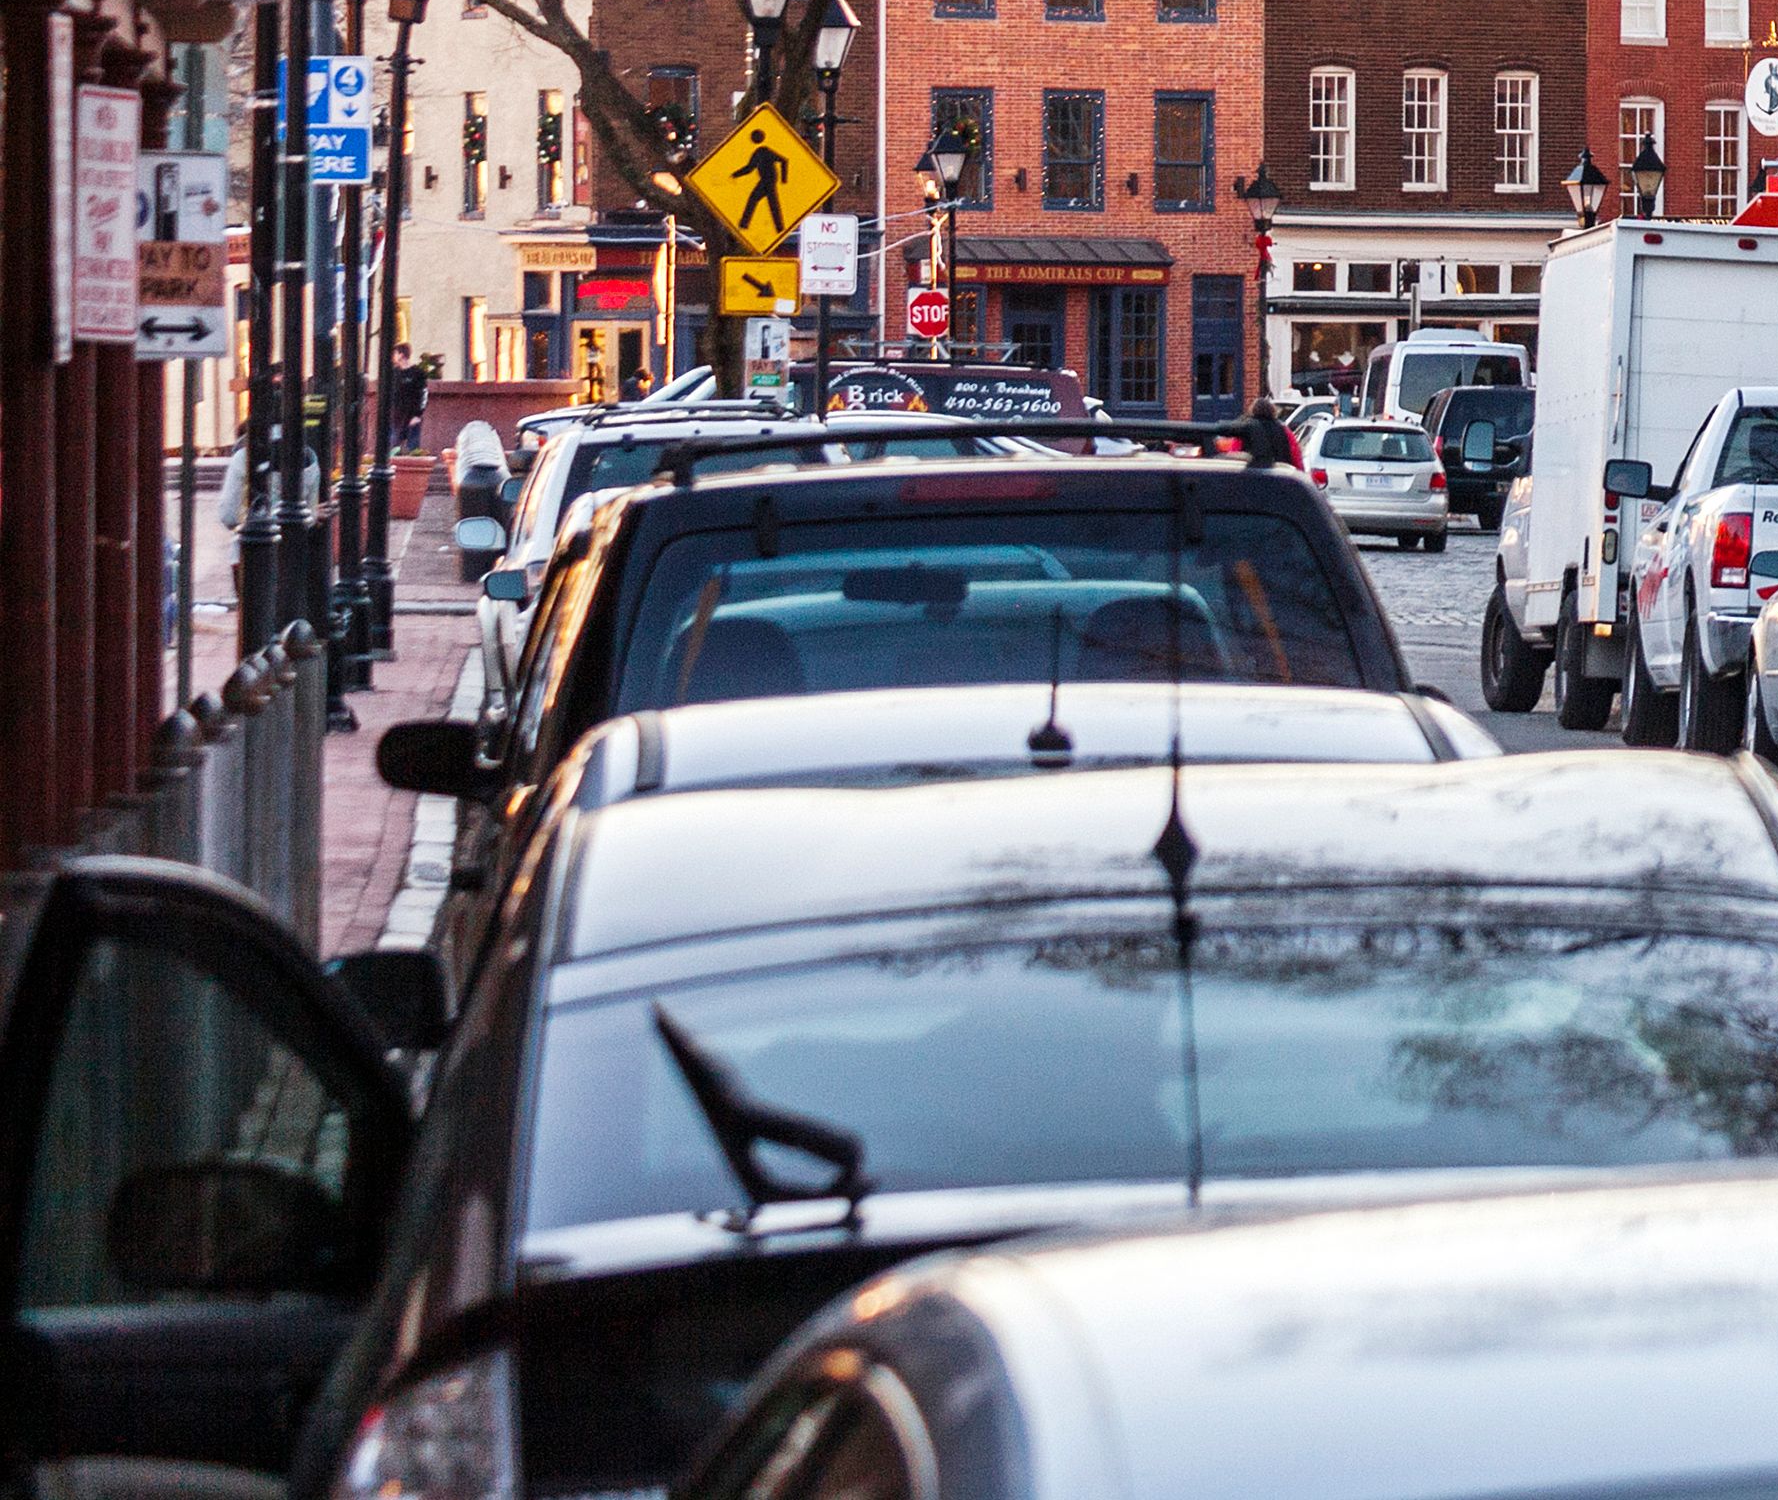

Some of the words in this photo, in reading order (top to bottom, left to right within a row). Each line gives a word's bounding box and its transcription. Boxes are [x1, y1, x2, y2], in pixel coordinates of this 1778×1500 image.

[340, 66, 358, 86] 4
[313, 155, 357, 173] ERE
[821, 221, 839, 234] NO
[985, 266, 1012, 278] THE
[1017, 267, 1093, 280] ADMIRALS
[911, 306, 949, 323] STOP
[847, 384, 905, 403] Brick
[994, 382, 1052, 400] Broadway
[944, 395, 1062, 414] 410-563-1600
